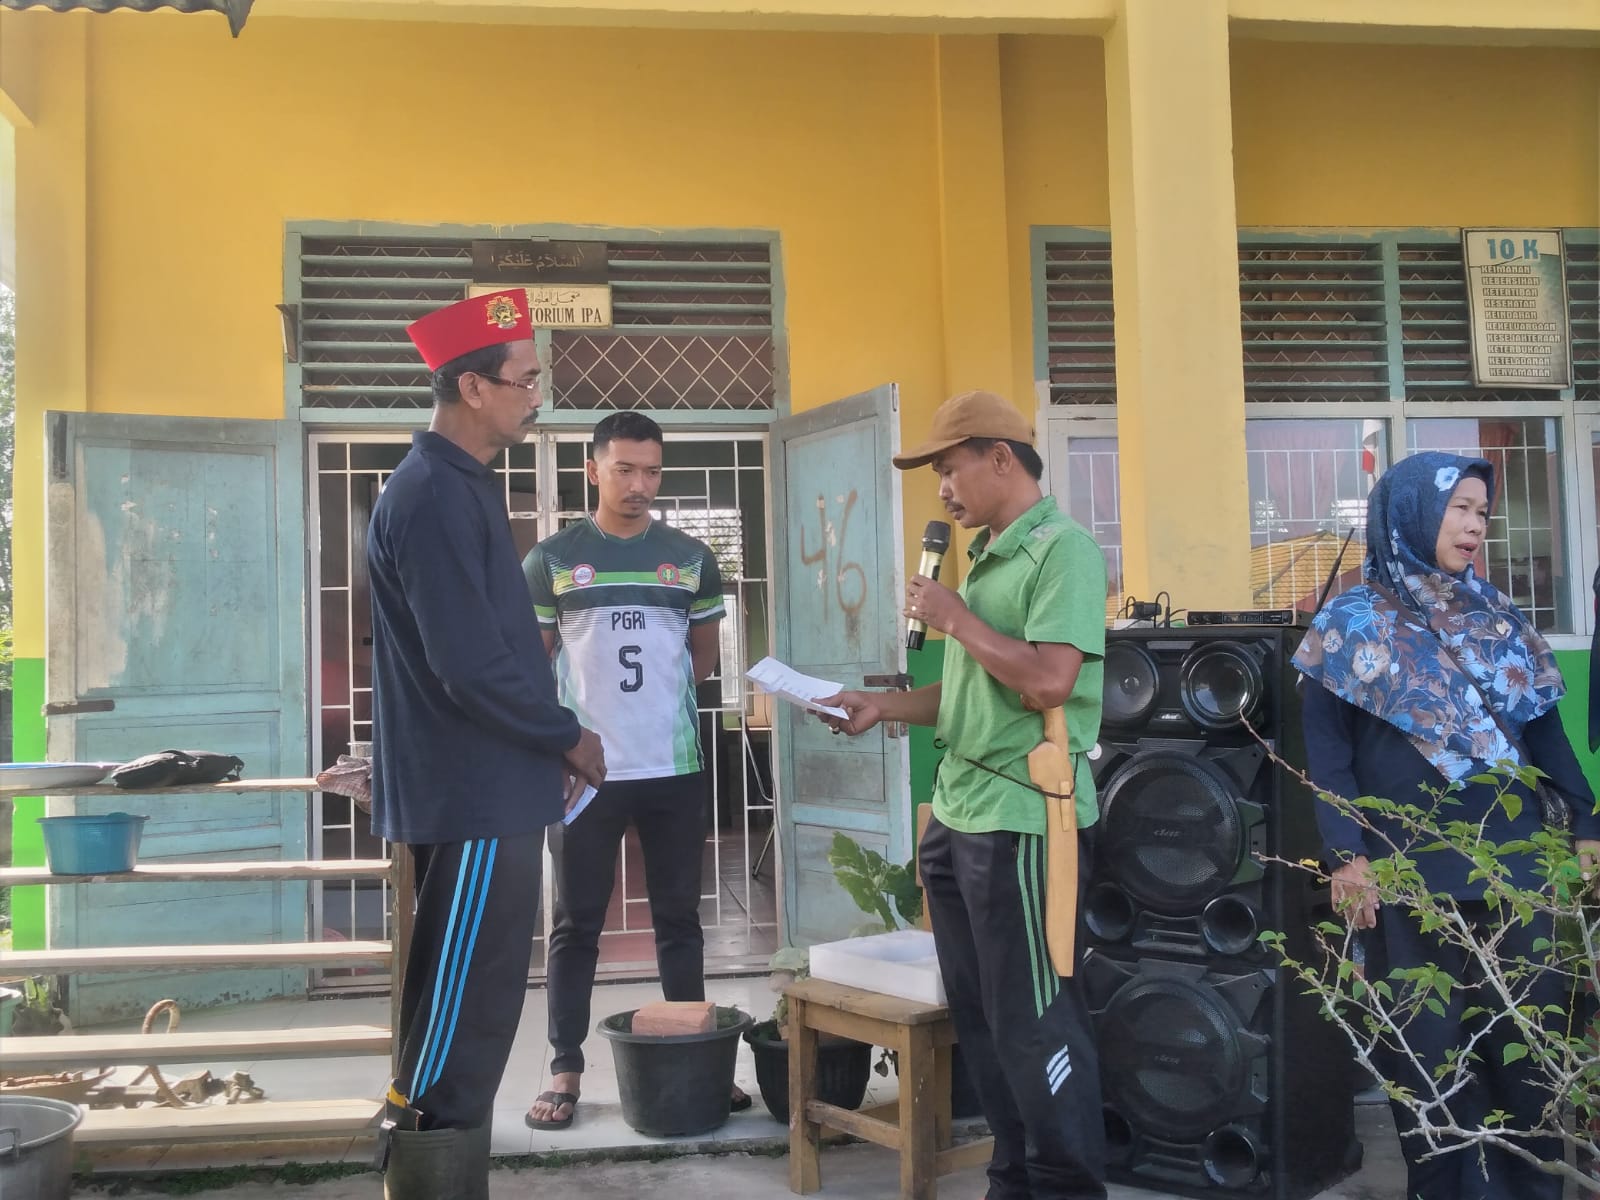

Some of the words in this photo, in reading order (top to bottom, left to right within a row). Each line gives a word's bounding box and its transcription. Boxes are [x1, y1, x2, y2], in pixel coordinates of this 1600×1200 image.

[1487, 238, 1514, 260] 10
[1522, 238, 1540, 260] K
[1481, 265, 1531, 274] KEIMANAN
[1482, 276, 1540, 286] KEBERSIHAN
[1483, 288, 1538, 297] KETERTIBAN
[1484, 299, 1536, 308] KESEHATAN
[528, 307, 574, 323] TORIUM
[582, 307, 602, 323] IPA
[1485, 311, 1537, 320] KEINDAHAN
[1487, 333, 1562, 343] KESEJAHTERAAN
[800, 488, 867, 624] 46
[612, 611, 646, 631] PGRI
